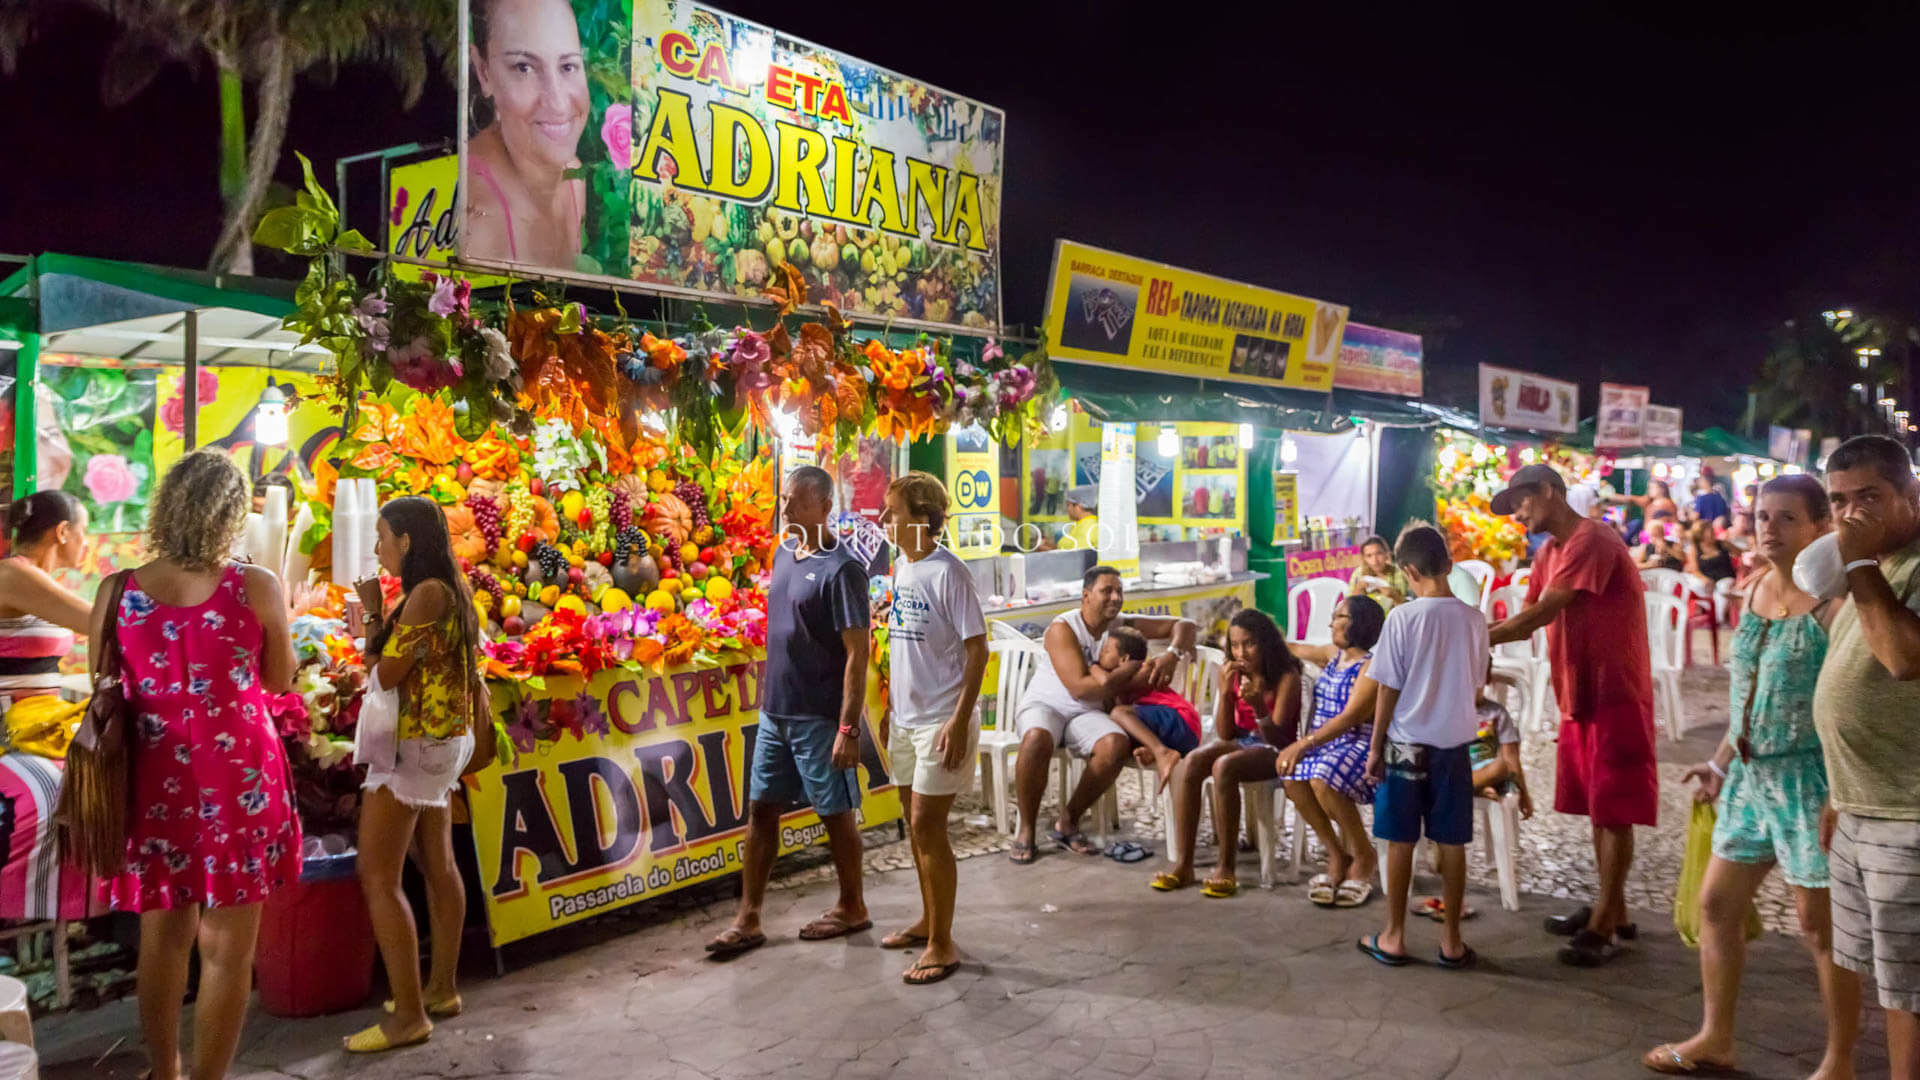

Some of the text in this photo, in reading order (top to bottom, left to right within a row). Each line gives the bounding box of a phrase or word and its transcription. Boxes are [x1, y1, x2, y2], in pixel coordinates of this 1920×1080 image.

[659, 30, 854, 127] CAETA
[632, 87, 990, 253] ADRIANA
[1071, 260, 1105, 277] BARRACA
[1146, 278, 1173, 317] REI
[1180, 290, 1221, 326] TAPIOCA
[550, 872, 645, 919] Passarela
[649, 865, 671, 889] do
[674, 848, 725, 881] álcool
[782, 823, 828, 848] Segur
